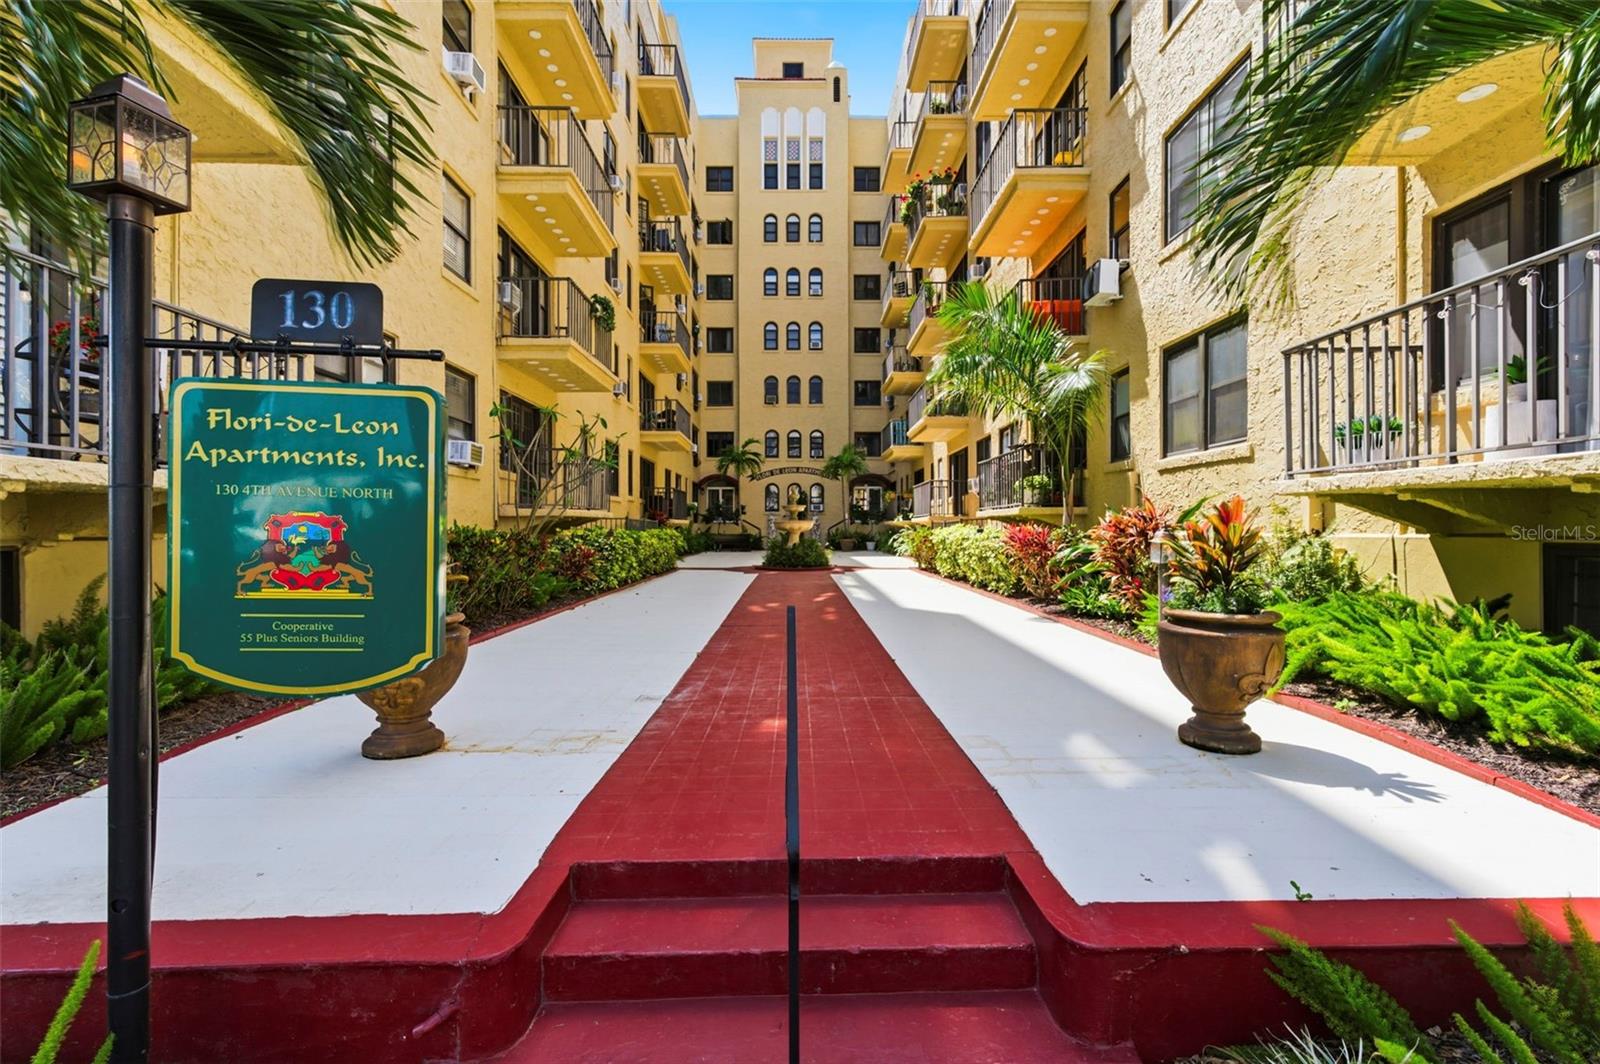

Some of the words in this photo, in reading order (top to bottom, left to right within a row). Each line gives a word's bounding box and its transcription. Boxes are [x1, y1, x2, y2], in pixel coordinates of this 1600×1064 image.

[279, 290, 355, 329] 130
[206, 408, 399, 435] Flori-de-Leon
[185, 441, 366, 468] Apartments,
[377, 447, 425, 468] Inc.
[215, 484, 239, 496] 130
[242, 484, 272, 497] 4TH
[276, 485, 338, 499] AVENUE
[341, 487, 394, 499] NORTH
[271, 621, 335, 633] Cooperative
[240, 633, 254, 643] 55
[256, 633, 279, 643] Plus
[280, 633, 319, 643] Seniors
[321, 634, 366, 645] Building
